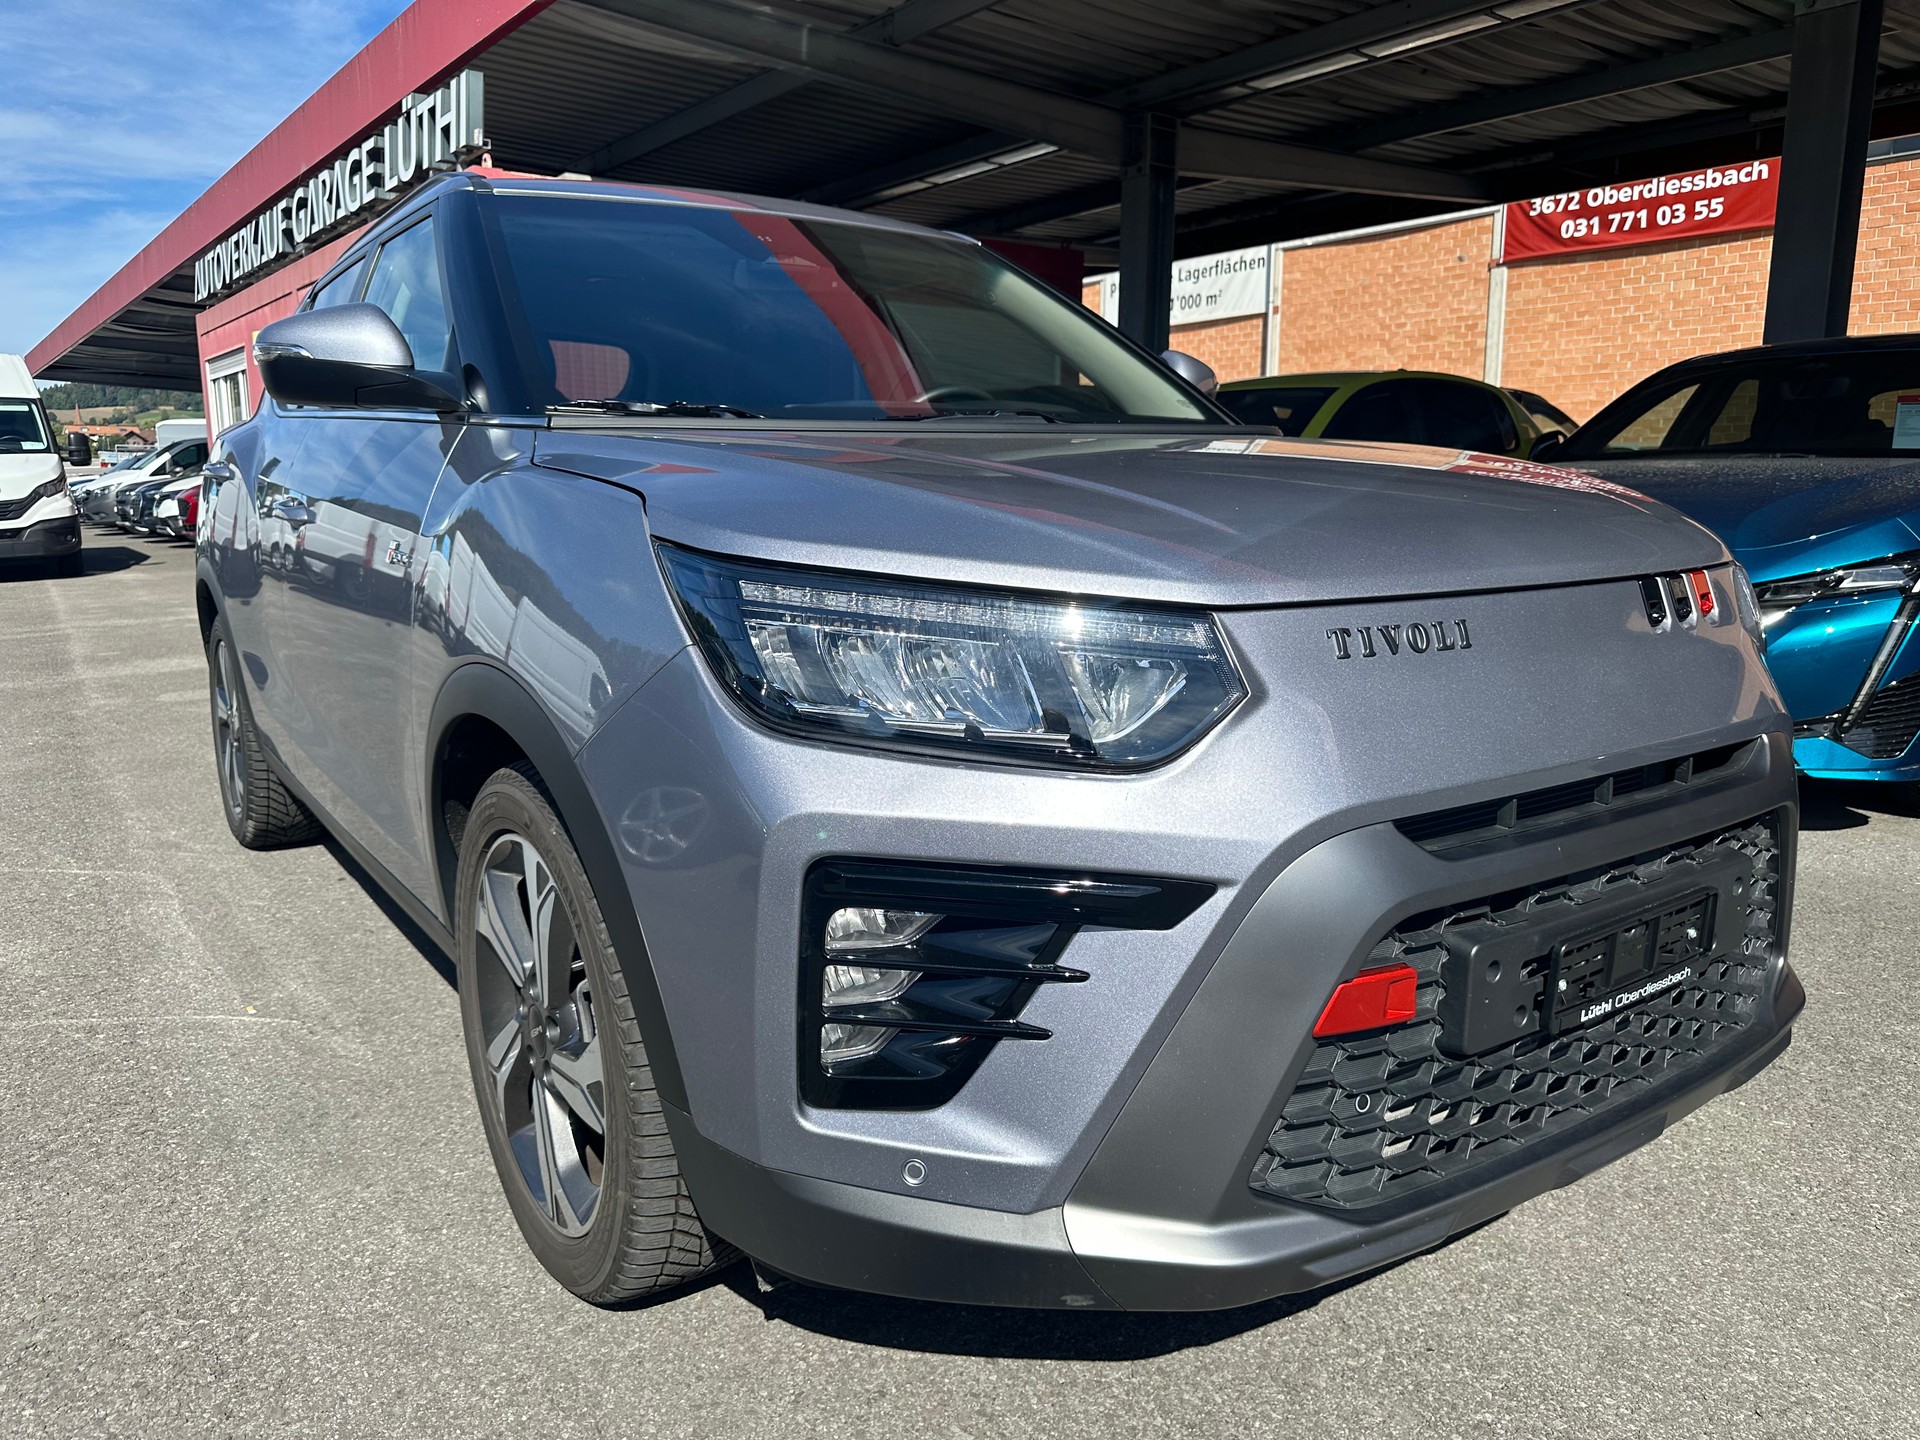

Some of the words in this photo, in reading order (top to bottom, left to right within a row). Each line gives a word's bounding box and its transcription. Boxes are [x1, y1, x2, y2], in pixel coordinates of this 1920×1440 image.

[194, 197, 293, 302] AUTOVERKAUF
[292, 134, 383, 244] GARAGE
[384, 69, 471, 192] LÜTHI
[1529, 191, 1580, 216] 3672
[1586, 161, 1769, 208] Oberdiessbach
[1560, 215, 1600, 239] 031
[1608, 208, 1648, 233] 771
[1656, 203, 1686, 226] 03
[1693, 197, 1725, 221] 55
[1178, 255, 1266, 284] Lagerflächen
[1326, 619, 1473, 660] TIVOLI
[1580, 998, 1613, 1022] Lüthi
[1614, 966, 1692, 1008] Oberdiessbach
